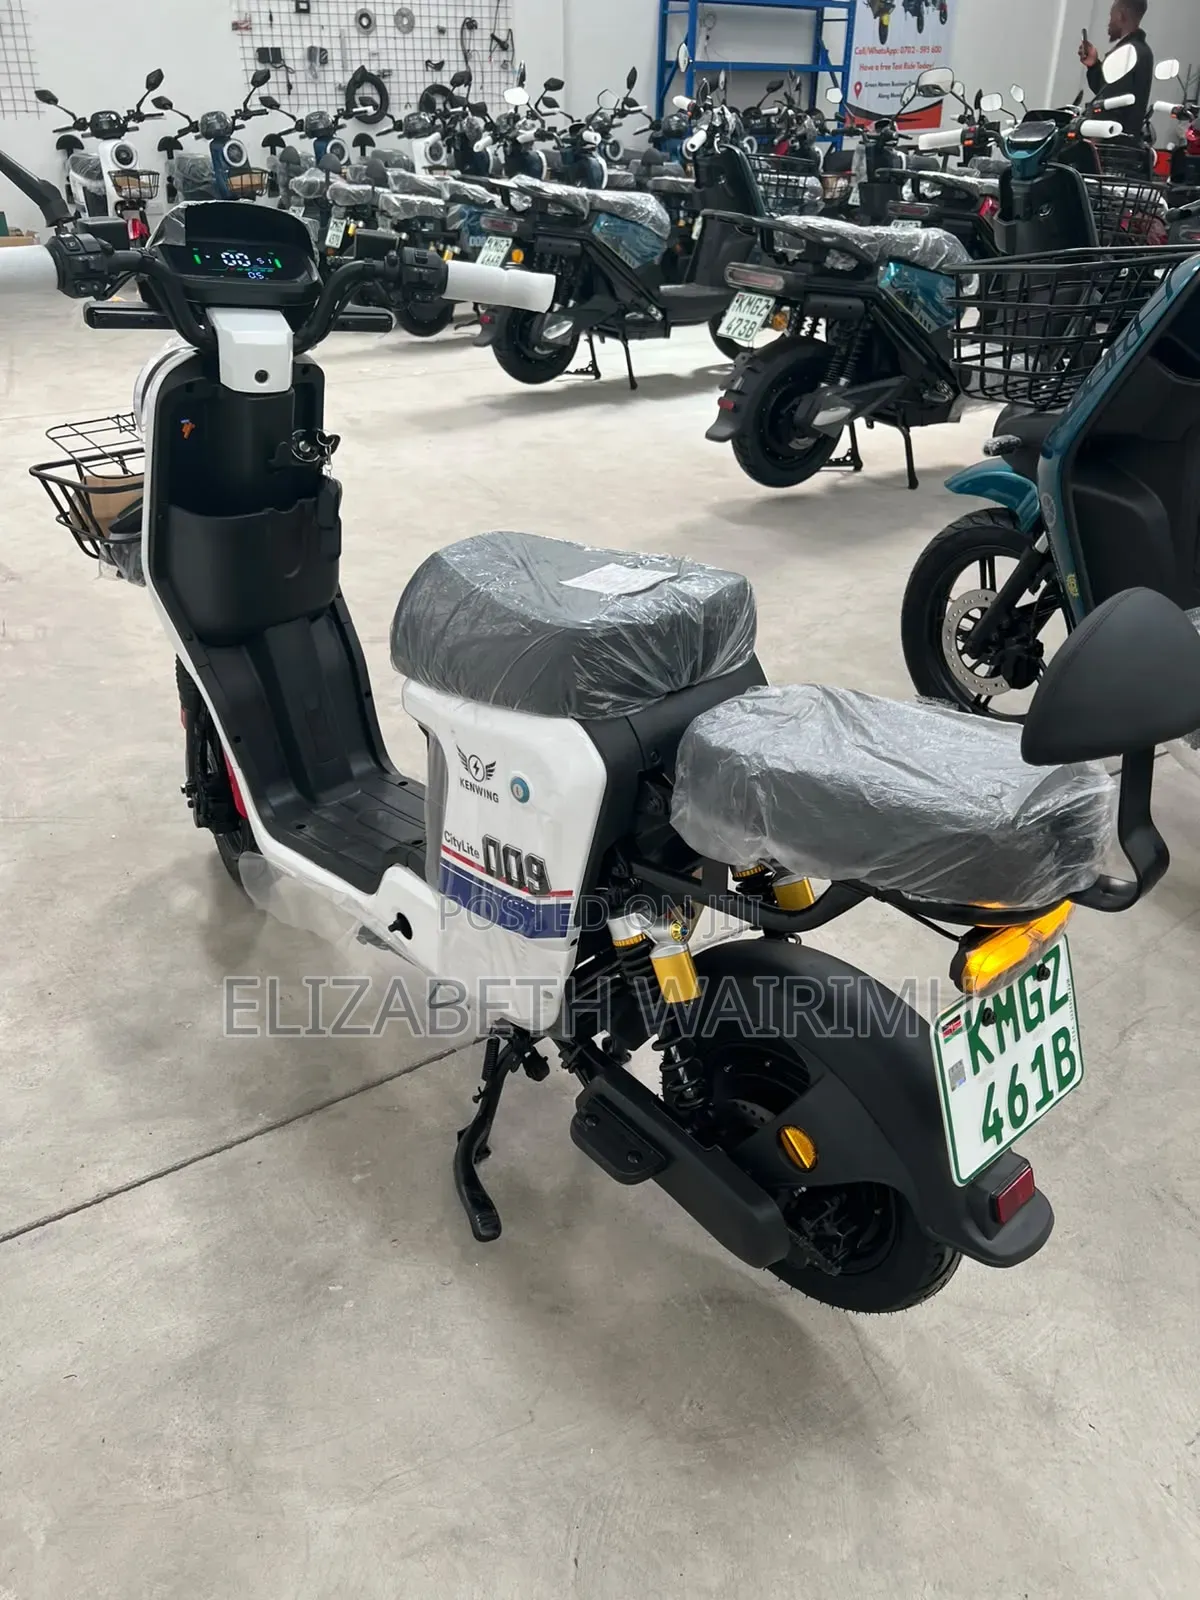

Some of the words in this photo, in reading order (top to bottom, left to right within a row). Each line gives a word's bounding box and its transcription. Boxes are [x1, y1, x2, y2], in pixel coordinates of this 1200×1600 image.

[859, 63, 873, 71] Have
[736, 295, 771, 317] KMGZ
[726, 317, 757, 338] 473B
[460, 777, 499, 803] KENWING
[444, 831, 480, 859] CityLite
[481, 833, 552, 896] 009
[964, 944, 1070, 1076] KMGZ
[981, 1026, 1077, 1146] 461B
